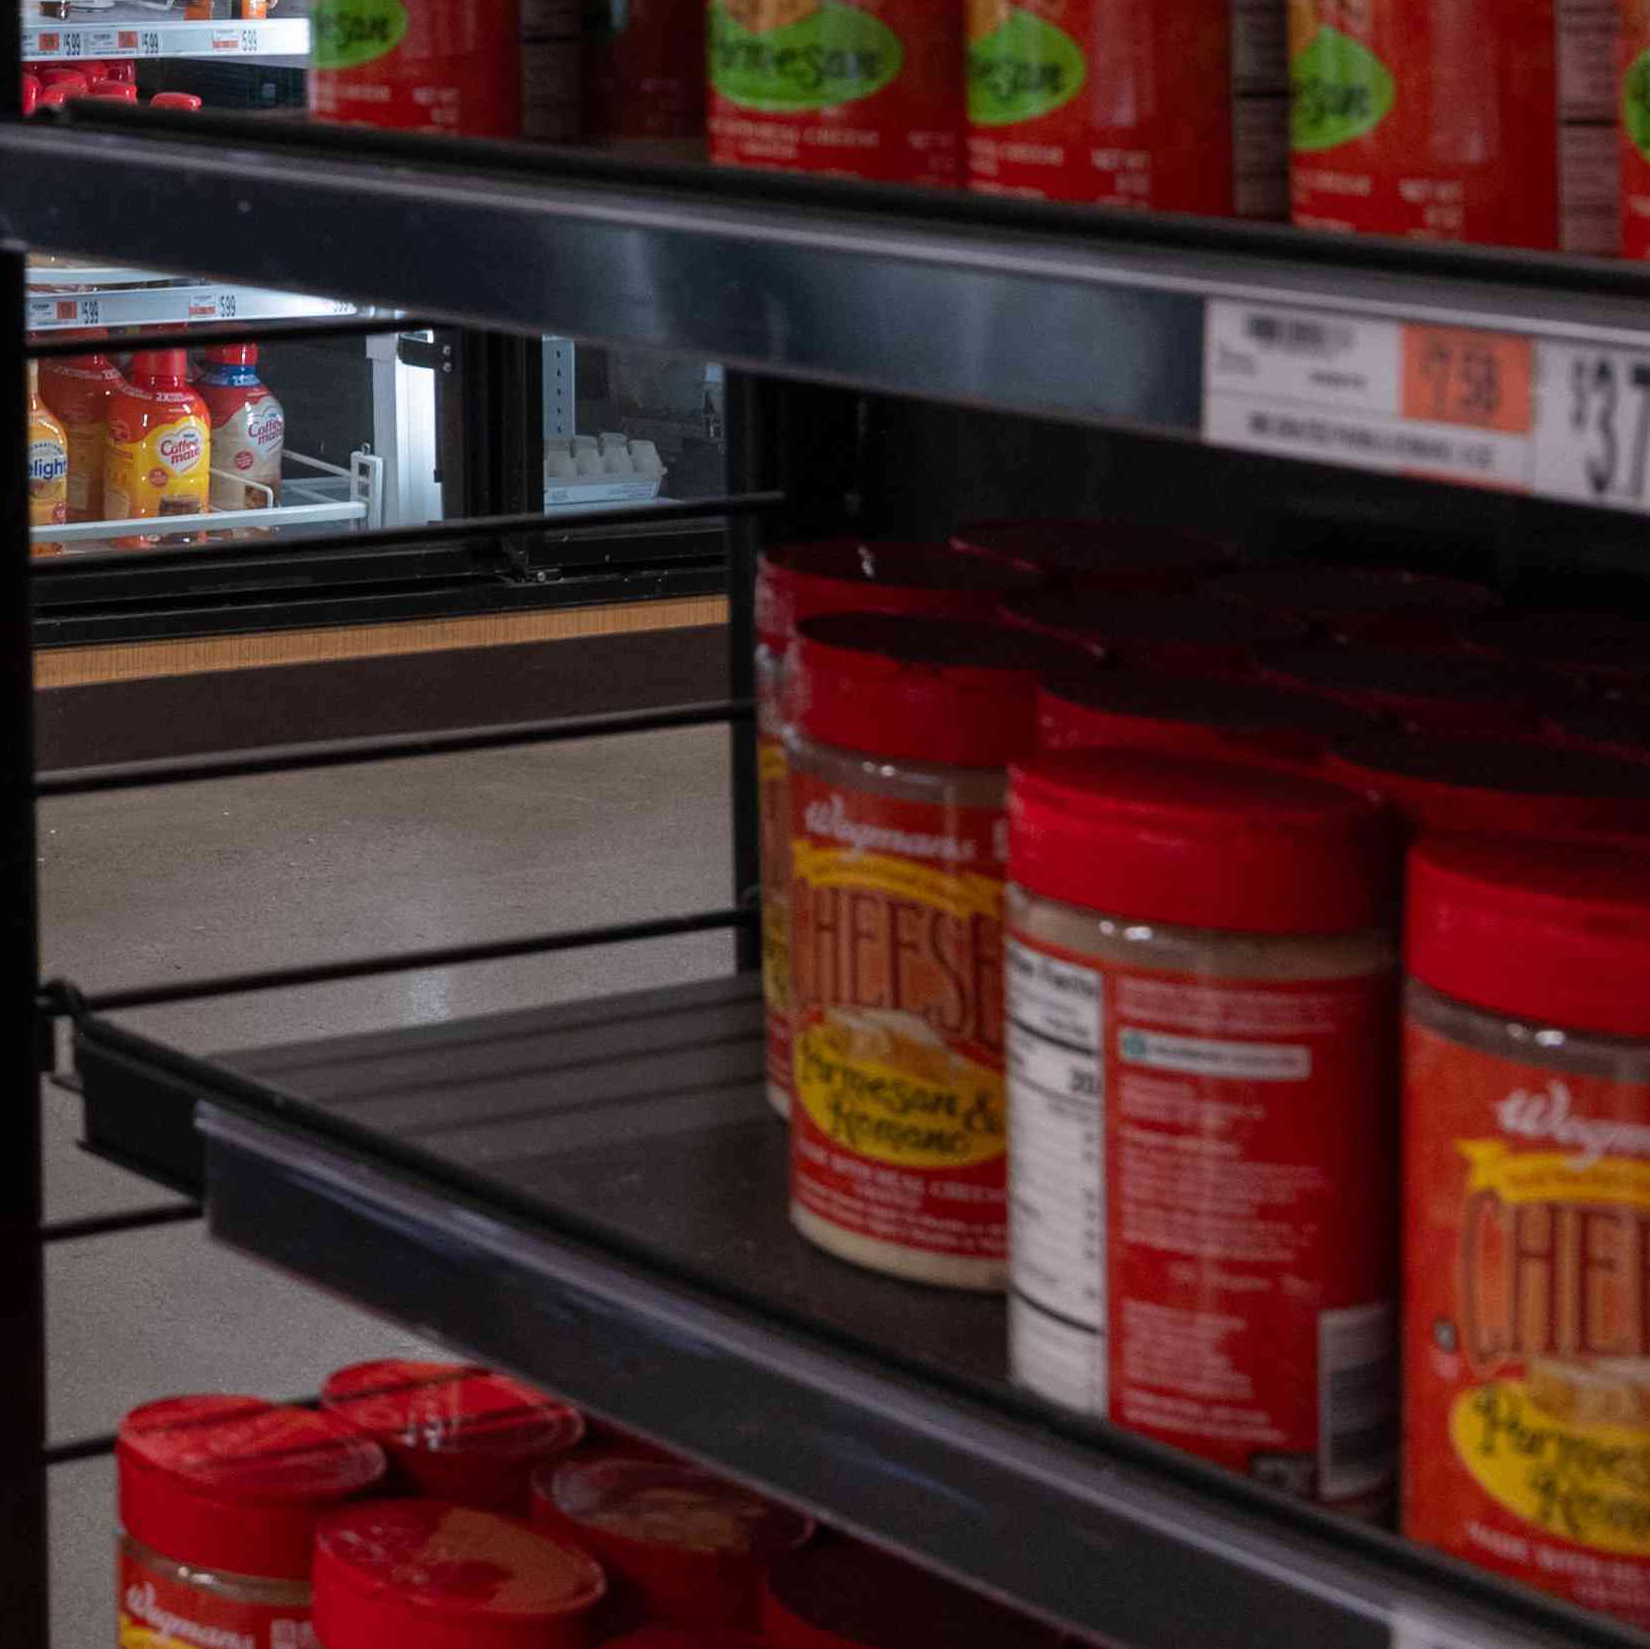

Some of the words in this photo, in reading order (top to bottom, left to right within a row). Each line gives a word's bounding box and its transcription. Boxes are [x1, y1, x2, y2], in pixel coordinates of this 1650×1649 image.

[248, 421, 283, 438] Coffee
[258, 431, 283, 445] mate
[161, 439, 199, 456] Coffee
[170, 449, 200, 465] mate
[805, 796, 974, 860] Wegmans
[963, 1092, 1000, 1138] &
